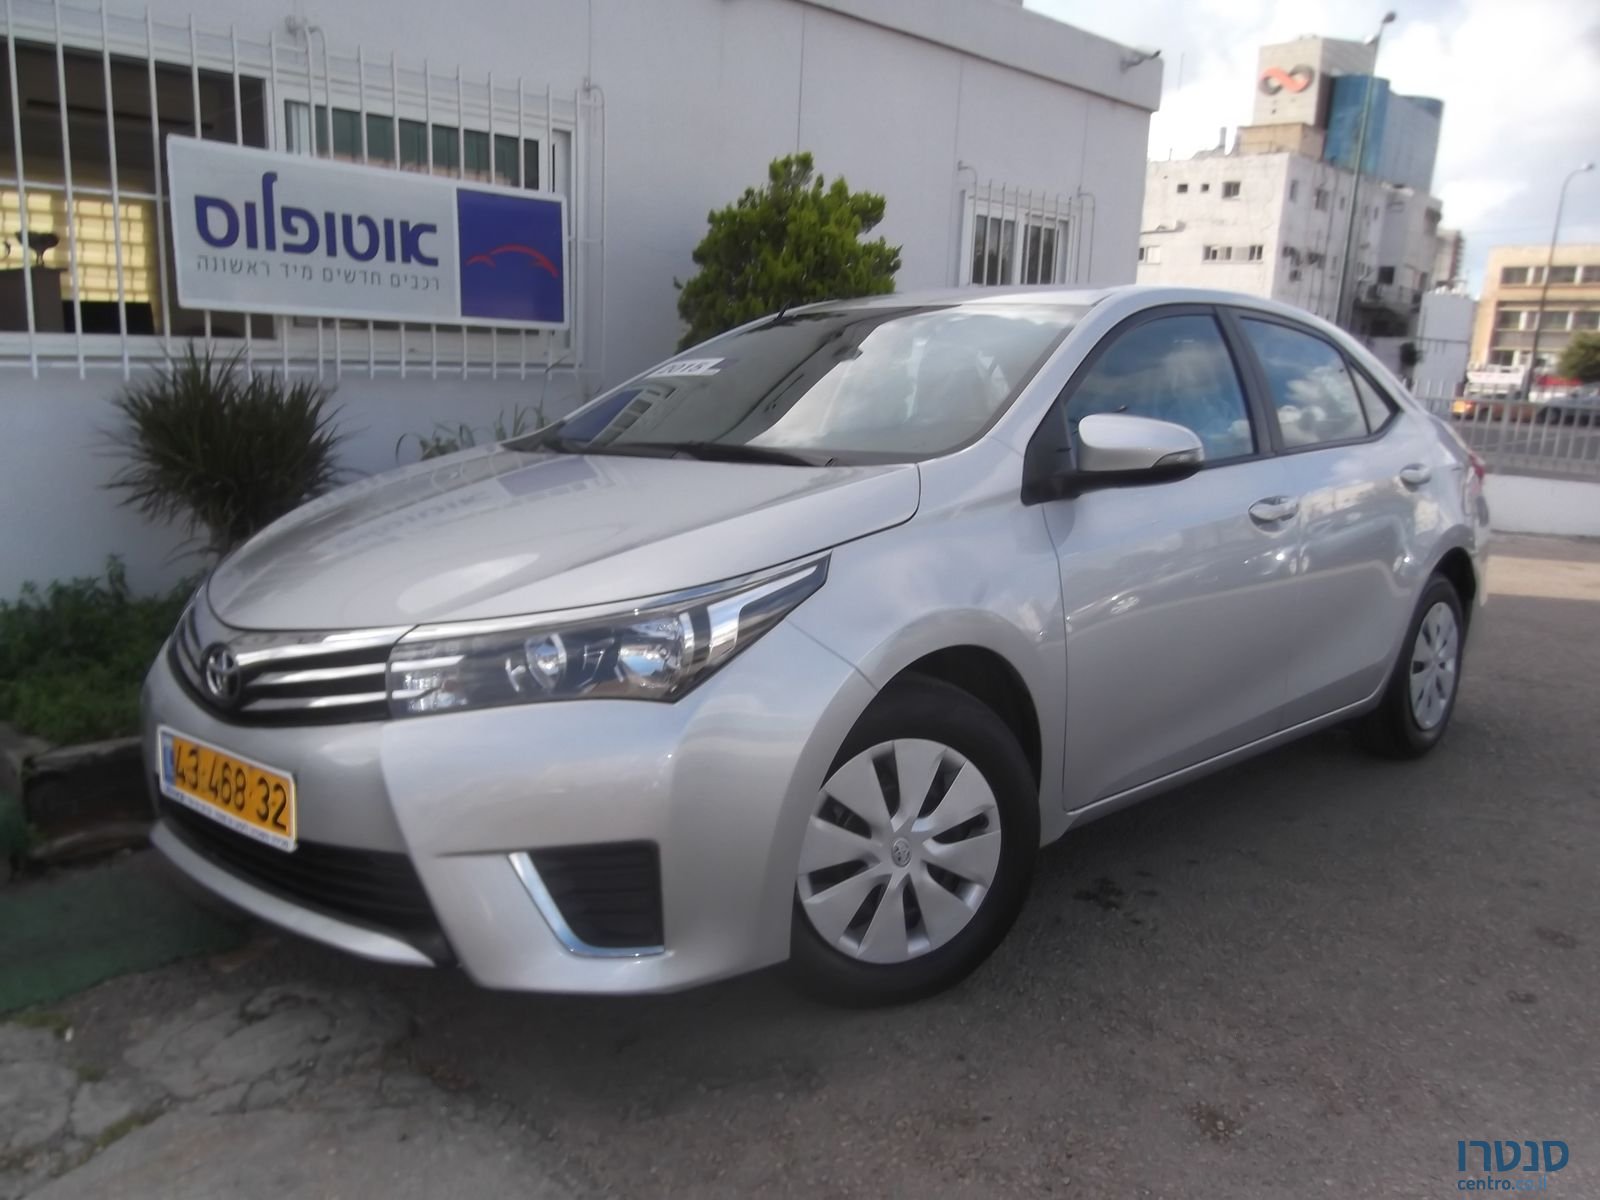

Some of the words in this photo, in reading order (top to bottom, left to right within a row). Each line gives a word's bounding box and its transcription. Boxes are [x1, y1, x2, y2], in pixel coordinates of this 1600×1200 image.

[195, 172, 438, 266] אוטופלוס
[197, 254, 270, 276] ראשונה
[280, 262, 313, 281] מיד
[322, 267, 381, 286] חדשים
[389, 273, 439, 291] רכבים
